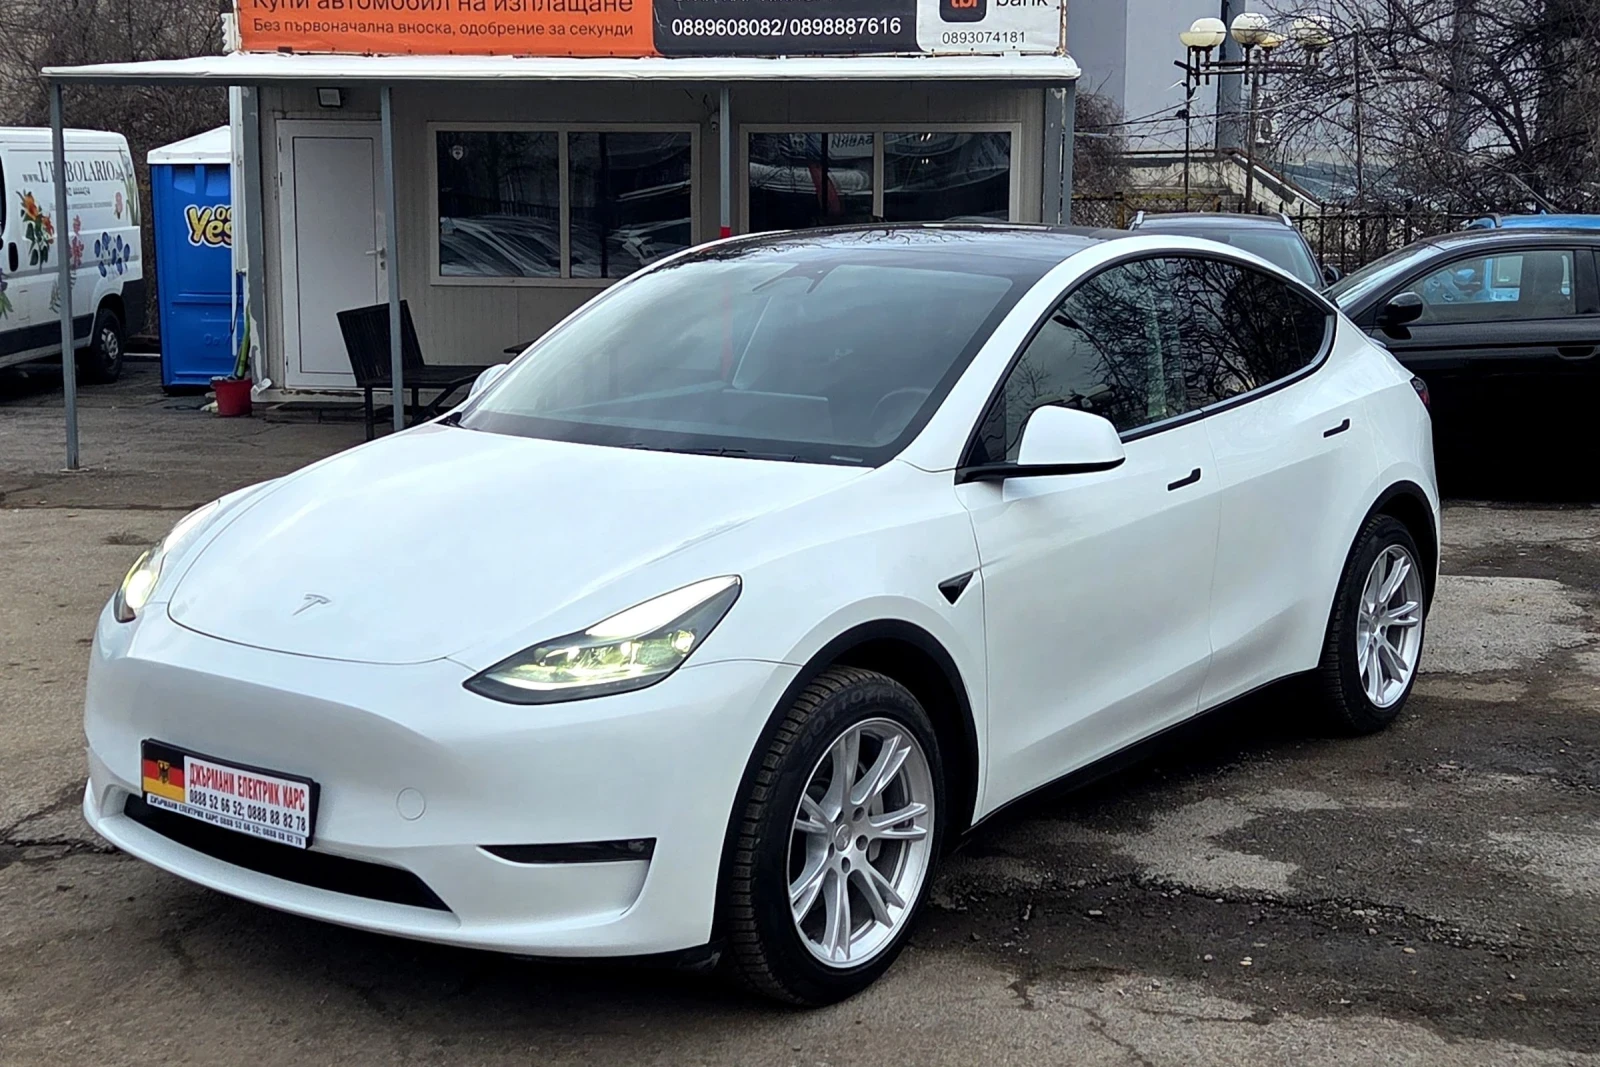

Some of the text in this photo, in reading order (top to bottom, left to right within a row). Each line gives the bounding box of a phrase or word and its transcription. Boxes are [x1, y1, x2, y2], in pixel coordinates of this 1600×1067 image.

[458, 0, 486, 12] на
[494, 0, 633, 16] изплащане
[253, 19, 633, 38] Без първоначална вноска, одобрение за секунди
[671, 17, 901, 36] 0889608082/0898887616
[942, 31, 1025, 44] 0893074181
[190, 763, 306, 812] ДЖЪРМАНИ ЕЛЕКТРИК КАРС
[189, 789, 207, 807] 0888
[209, 794, 218, 810] 52
[247, 804, 267, 823] 0888
[270, 809, 280, 826] 88
[283, 812, 293, 829] 82
[296, 815, 306, 832] 78
